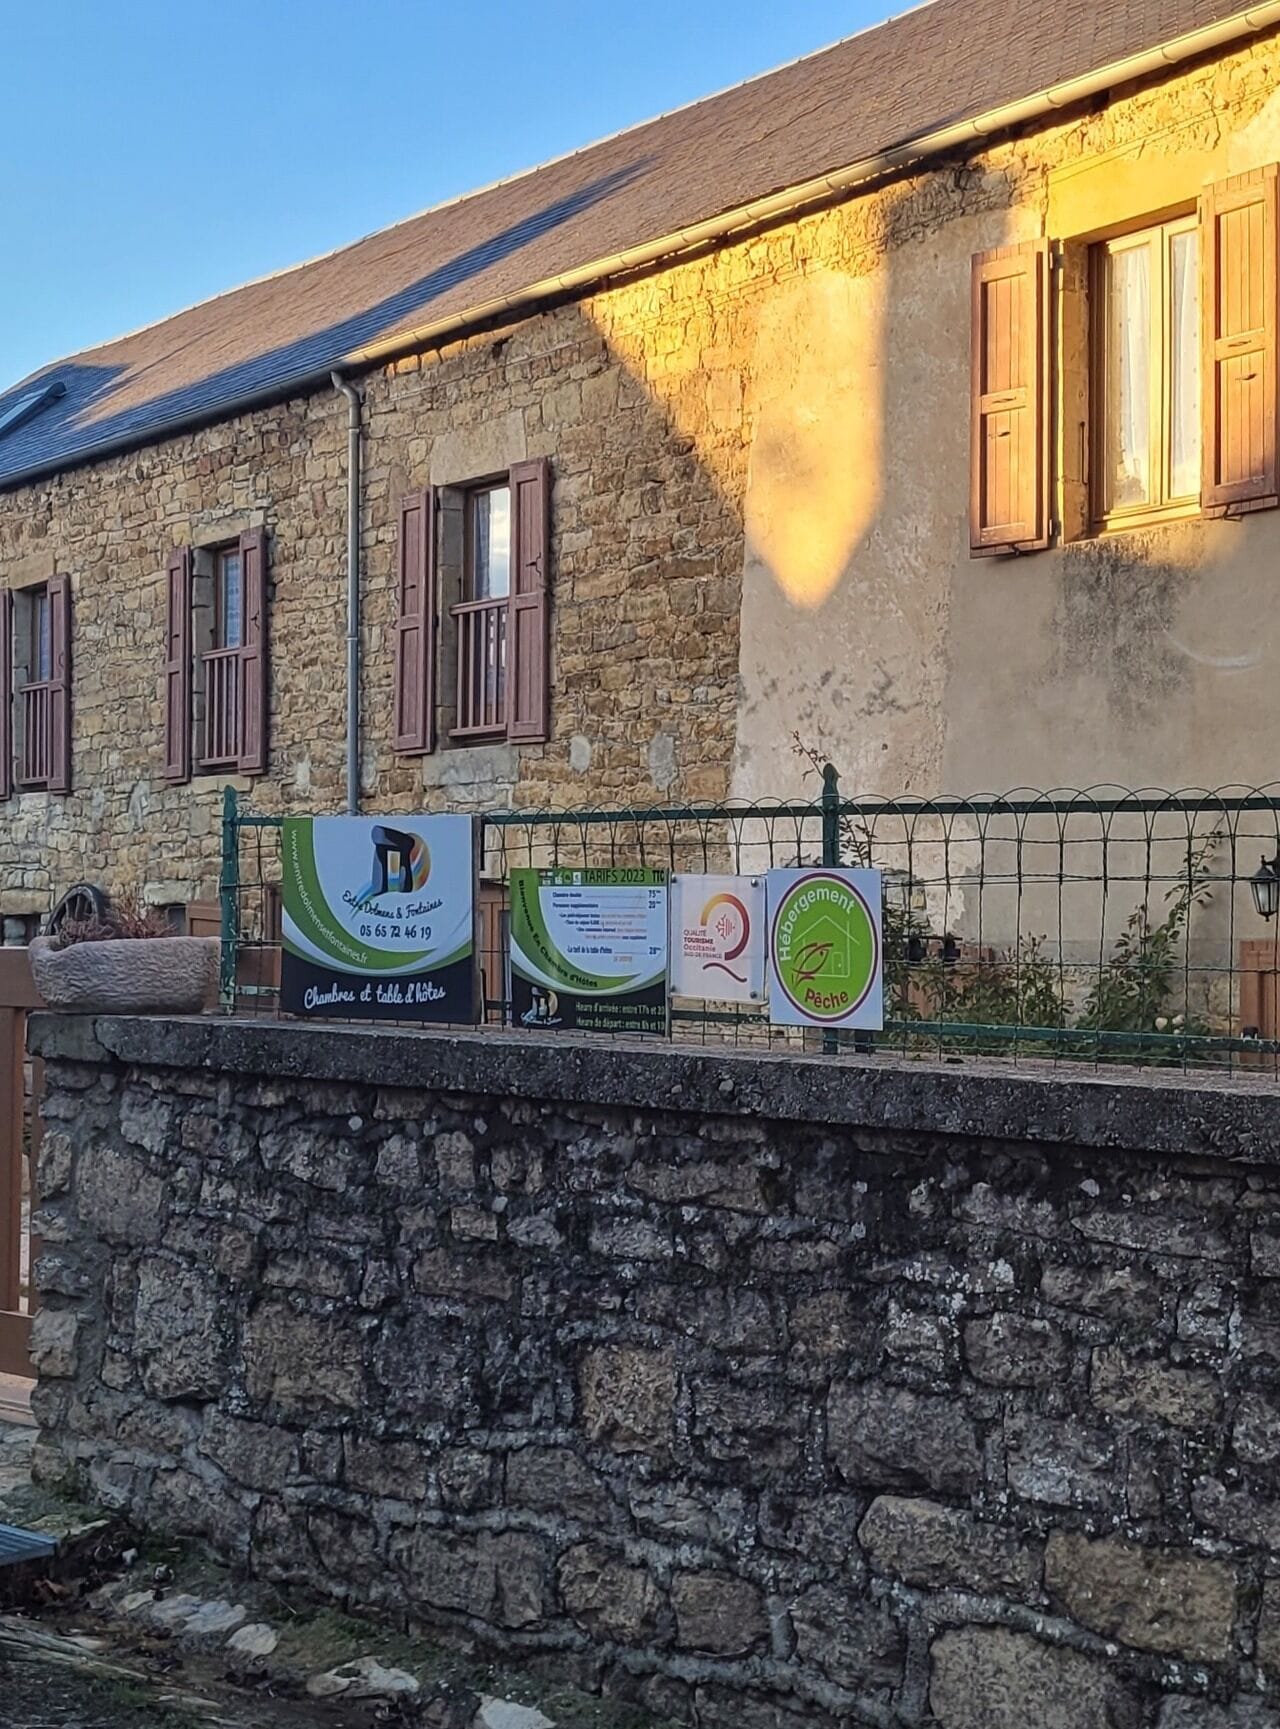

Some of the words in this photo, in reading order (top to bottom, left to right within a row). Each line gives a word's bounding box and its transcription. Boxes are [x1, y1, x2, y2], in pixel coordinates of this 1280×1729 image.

[584, 870, 617, 883] TARIFS
[620, 870, 645, 883] 2023
[396, 907, 403, 919] &
[405, 899, 443, 919] Fontaines
[360, 924, 372, 937] 05
[375, 923, 387, 937] 65
[390, 925, 401, 938] 72
[405, 924, 417, 938] 46
[421, 926, 432, 940] 19
[518, 880, 534, 932] Bienvenue
[540, 946, 569, 977] Chambre
[780, 888, 856, 961] Hébergement
[683, 936, 714, 944] TOURISME
[683, 943, 716, 952] Occitanie
[304, 982, 356, 1009] Chambres
[360, 983, 372, 1001] et
[376, 983, 404, 1004] table
[404, 981, 446, 1004] d'hôtes
[804, 988, 849, 1009] Pêche
[575, 1001, 593, 1012] Heure
[576, 1016, 593, 1027] Heure
